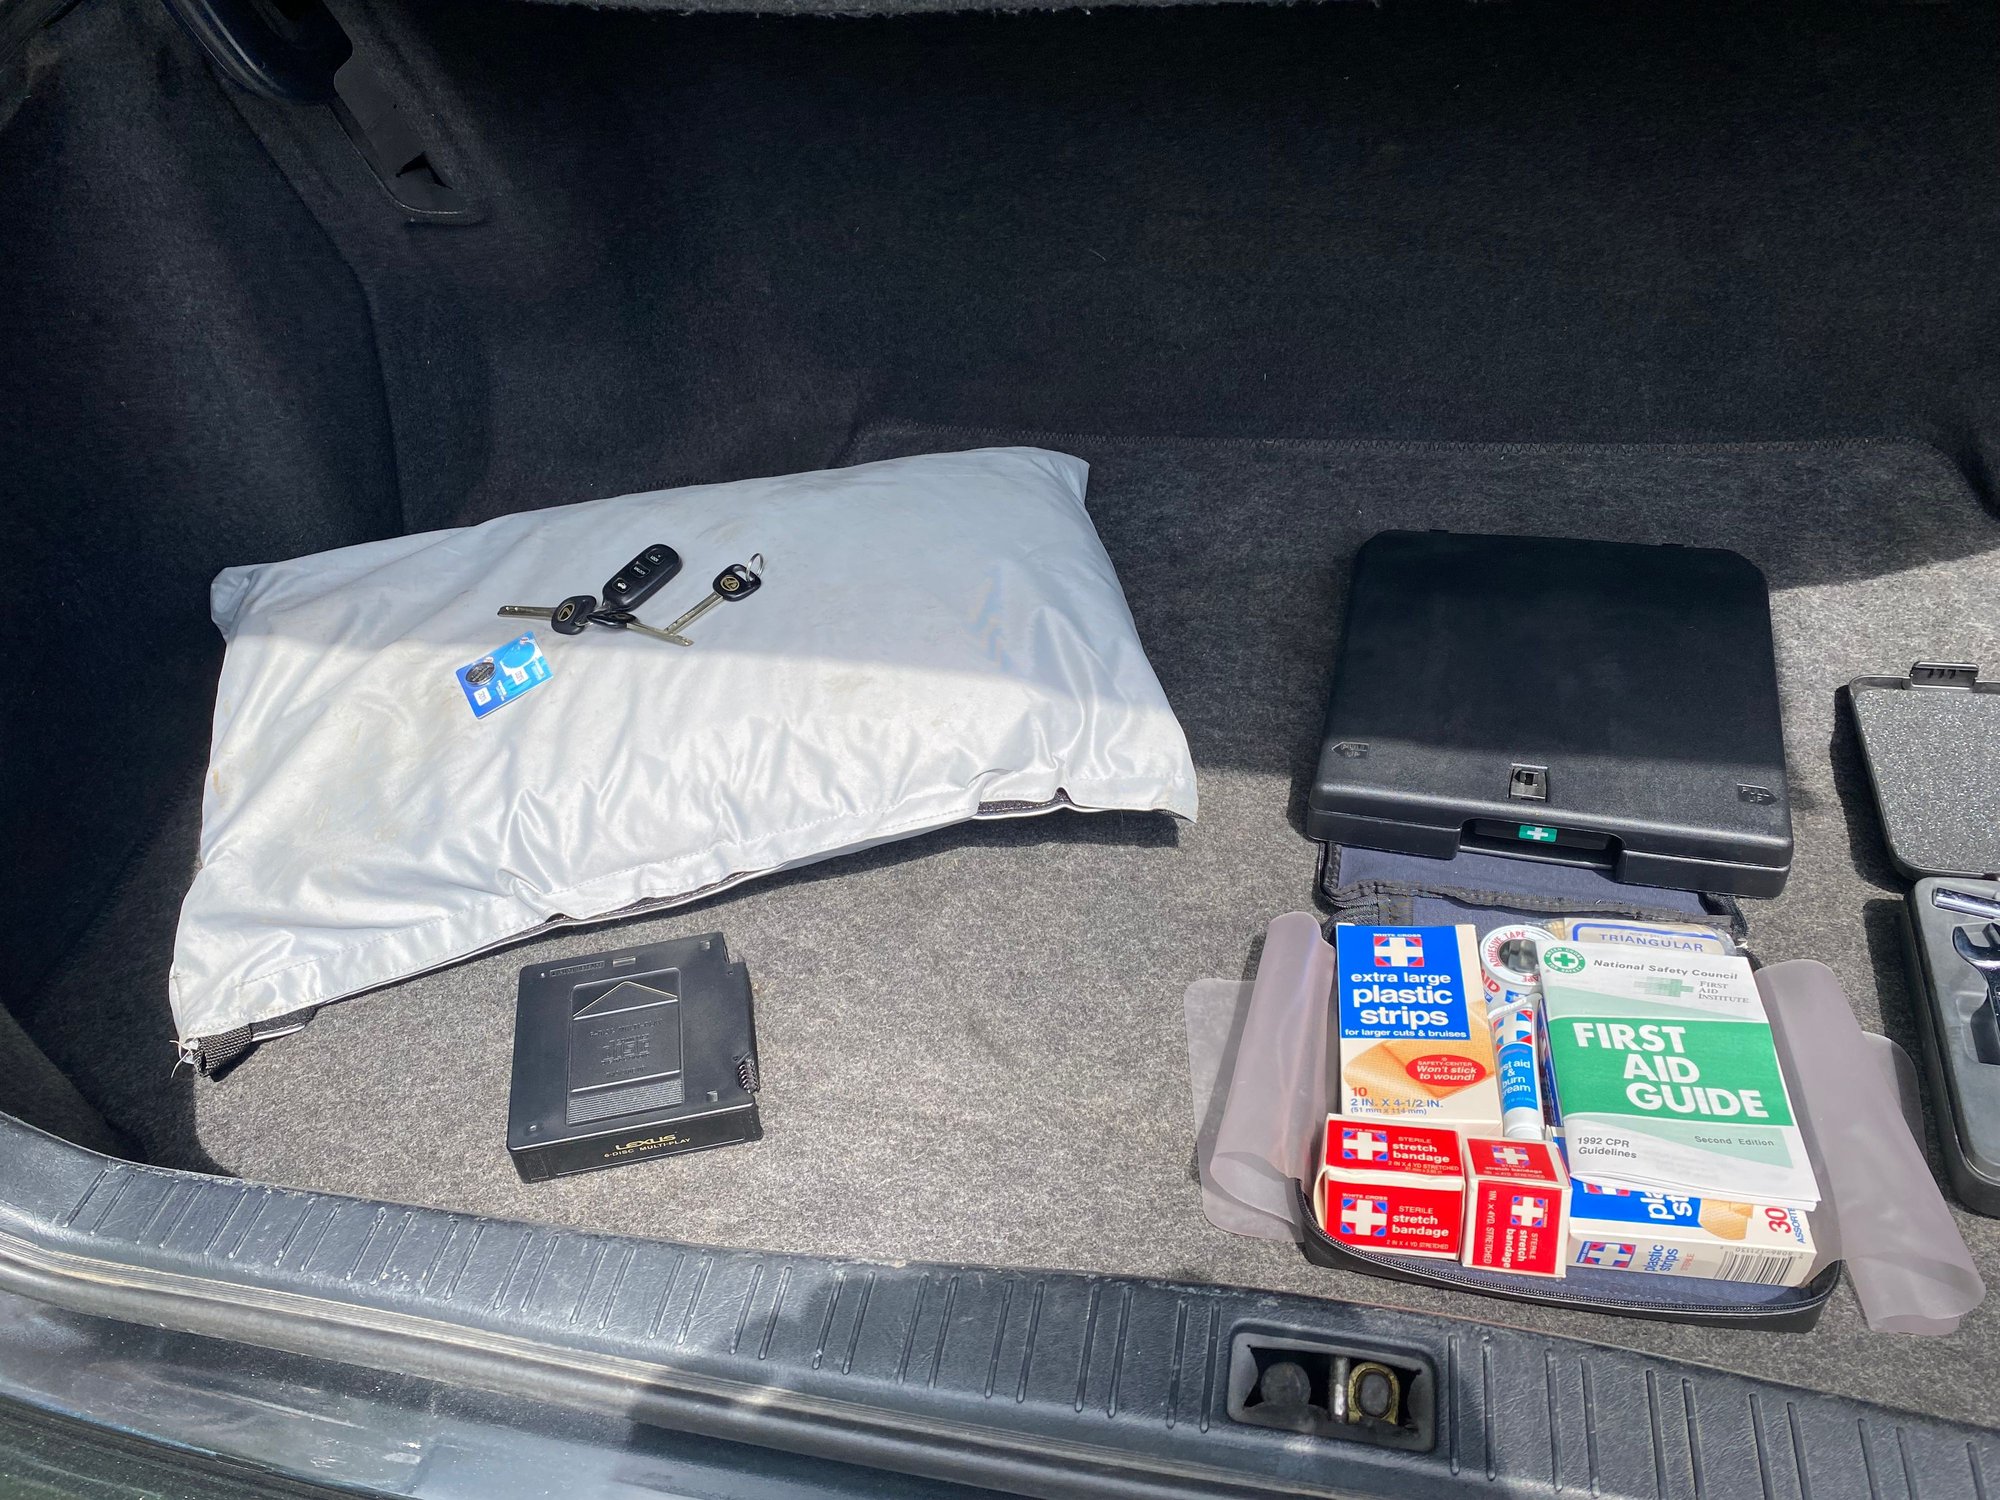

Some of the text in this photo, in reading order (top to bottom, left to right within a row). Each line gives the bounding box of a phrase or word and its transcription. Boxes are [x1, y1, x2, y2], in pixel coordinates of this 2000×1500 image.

[1504, 931, 1526, 939] TAPE
[1599, 934, 1704, 952] TRIANGULAR
[1593, 960, 1738, 980] National Safety Council
[1351, 972, 1451, 986] extra large
[1700, 981, 1729, 989] FIRST
[1353, 985, 1453, 1008] plastic
[1698, 994, 1750, 1004] INSTITUTE
[1360, 1006, 1449, 1030] strips
[1362, 1029, 1390, 1038] larger
[1393, 1029, 1415, 1037] cuts
[1428, 1029, 1467, 1038] bruises
[1572, 1022, 1686, 1053] FIRST
[1417, 1065, 1477, 1074] Won't stick
[1513, 1059, 1531, 1069] aid
[1623, 1054, 1700, 1084] AID
[1433, 1073, 1475, 1081] wound!
[1508, 1068, 1516, 1077] &
[1352, 1087, 1367, 1097] 10
[1361, 1099, 1378, 1107] IN.
[1393, 1099, 1422, 1107] 4-1/2
[1427, 1100, 1443, 1108] IN.
[1626, 1082, 1770, 1118] GUIDE
[615, 1134, 676, 1150] LEXUS
[1398, 1136, 1432, 1144] STERILE
[1577, 1137, 1630, 1148] 1992 CPR
[1695, 1136, 1774, 1146] Second Edition
[604, 1138, 691, 1158] 6-DISC MULTI-PLAY
[1392, 1143, 1437, 1152] stretch
[1578, 1147, 1637, 1159] Guidelines
[1393, 1151, 1450, 1164] bandage
[1399, 1206, 1434, 1214] STERILE
[1392, 1214, 1438, 1225] stretch
[1765, 1207, 1792, 1234] 30
[1788, 1207, 1806, 1244] ASSORTE
[1392, 1224, 1449, 1238] bandage
[1420, 1242, 1449, 1250] STRETCHED
[1484, 1227, 1495, 1264] STRETCHED
[1502, 1228, 1516, 1268] bandage
[1517, 1230, 1528, 1262] stretch
[1529, 1232, 1538, 1260] STERILE
[1645, 1244, 1665, 1272] plastic
[1659, 1248, 1679, 1272] strips
